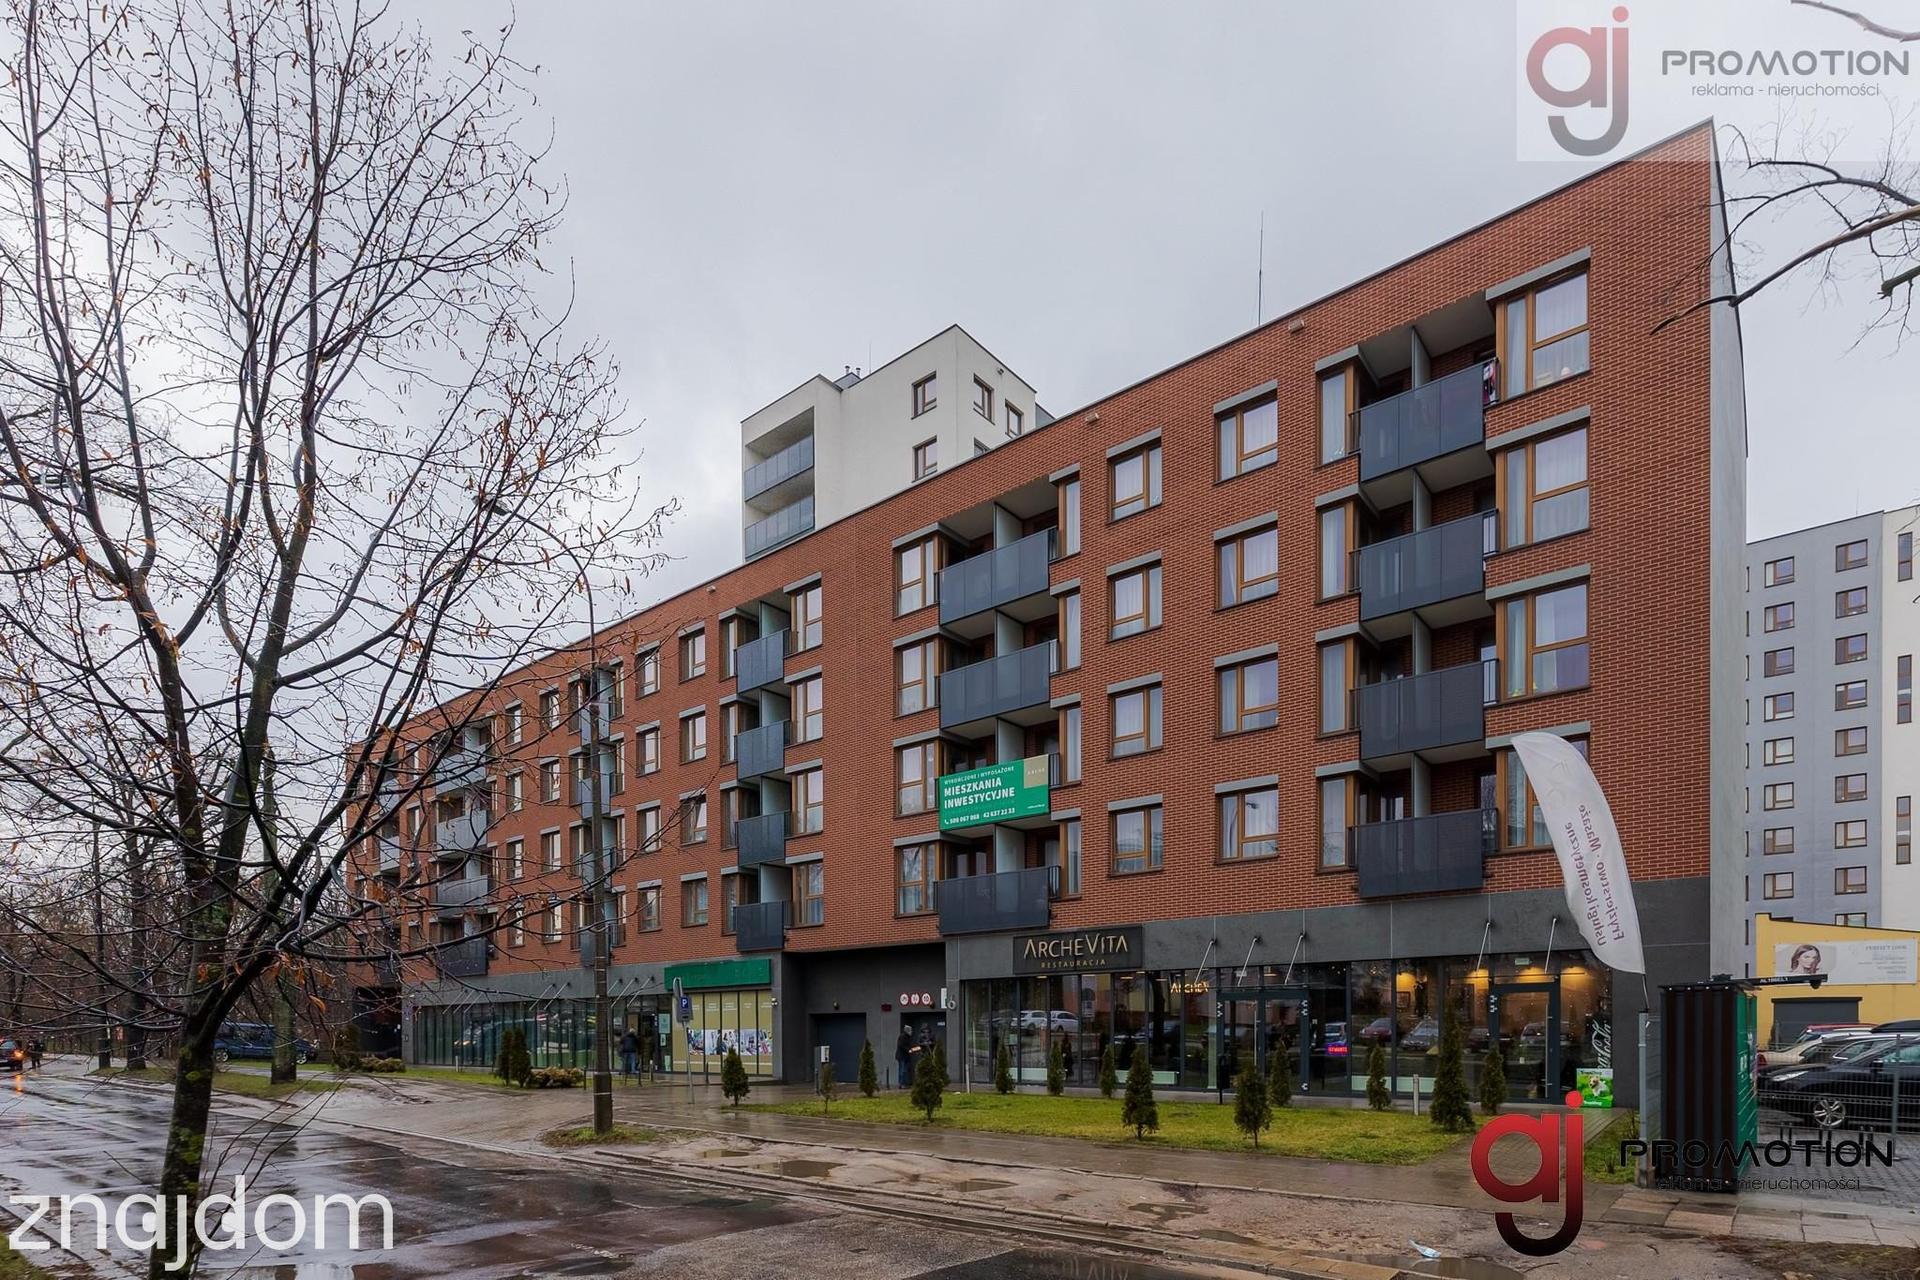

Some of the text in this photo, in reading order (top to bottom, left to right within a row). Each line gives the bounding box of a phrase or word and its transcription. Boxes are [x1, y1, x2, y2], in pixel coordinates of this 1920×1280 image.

[944, 777, 1002, 797] MIESZKANIA
[944, 787, 1015, 809] INWESTYCYJNE
[1041, 959, 1106, 969] RESTAURACJA
[682, 998, 688, 1007] P
